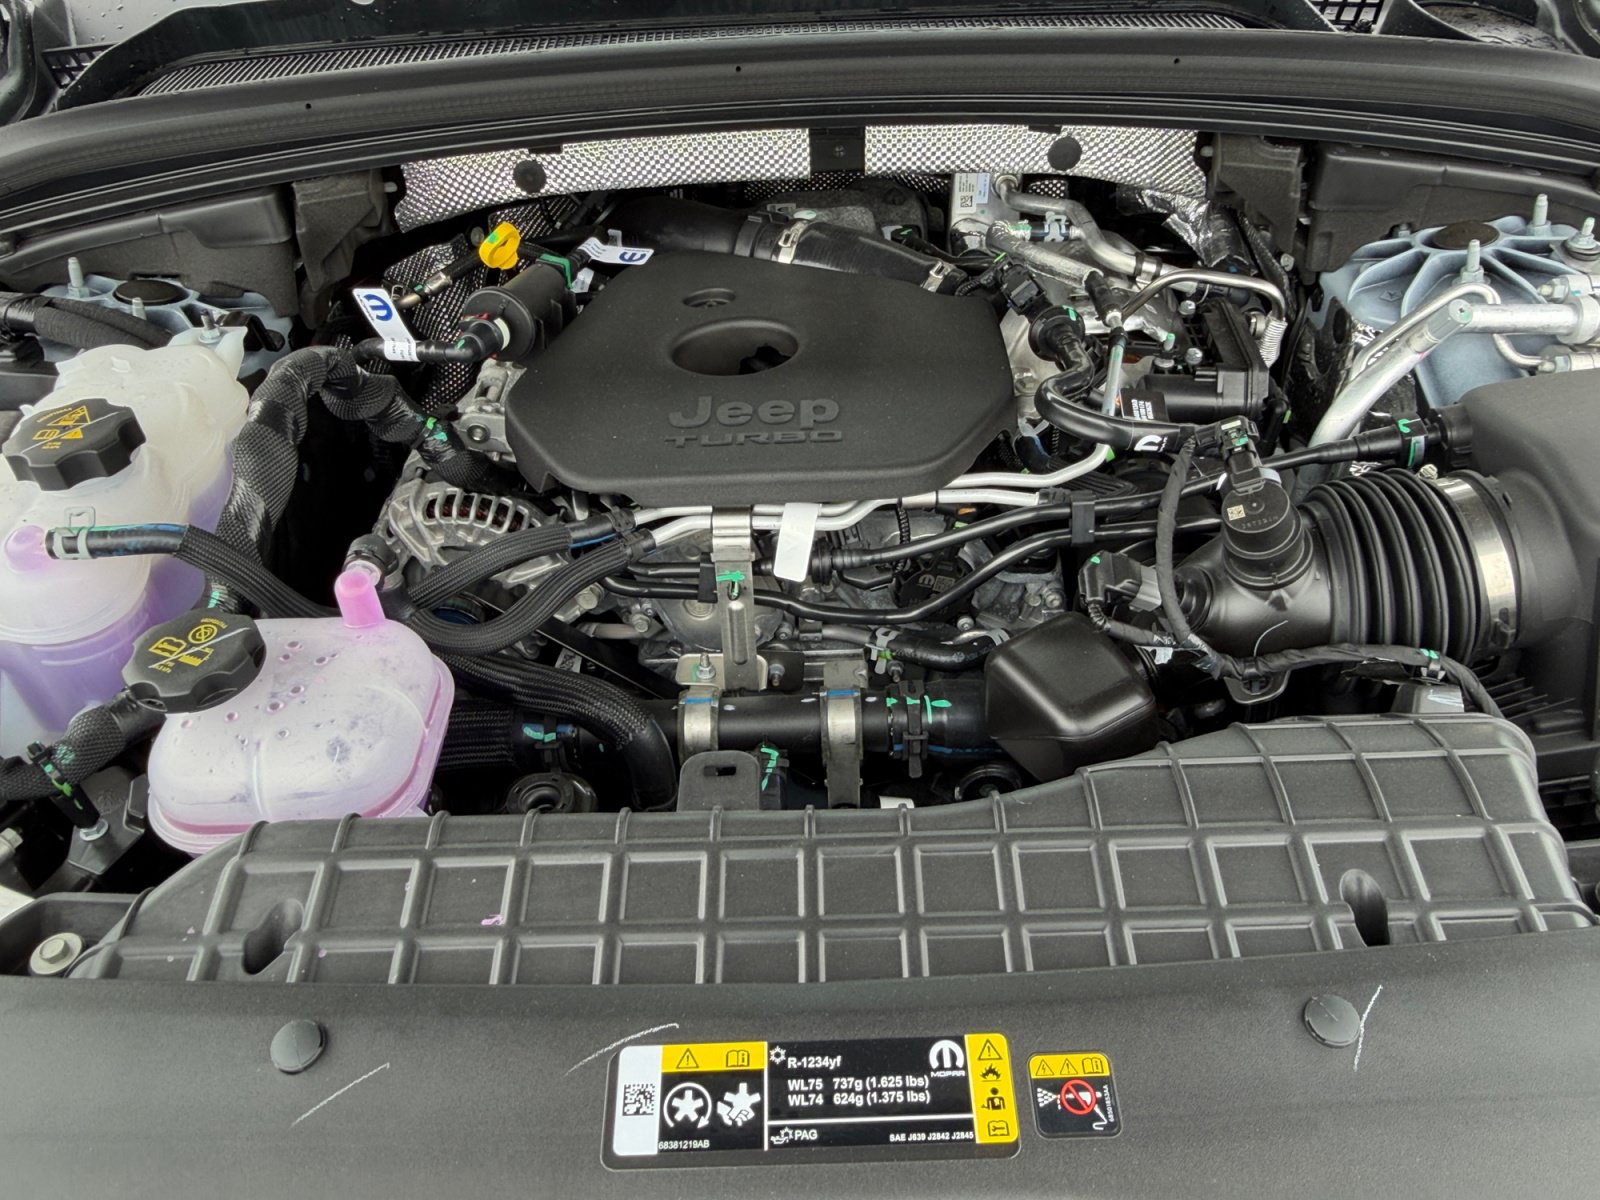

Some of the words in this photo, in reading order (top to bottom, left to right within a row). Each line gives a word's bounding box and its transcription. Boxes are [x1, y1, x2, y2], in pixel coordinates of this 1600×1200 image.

[668, 395, 840, 430] Jeep
[664, 430, 843, 448] TURBO
[787, 1055, 842, 1071] R-1234yf
[930, 1069, 966, 1078] MOPAR
[787, 1078, 824, 1092] WL75
[832, 1076, 863, 1092] 737g
[865, 1075, 904, 1091] (1.625
[905, 1074, 930, 1090] lbs)
[787, 1093, 825, 1107] WL74
[832, 1092, 864, 1108] 624g
[865, 1090, 905, 1107] (1.375
[906, 1089, 931, 1105] lbs)
[794, 1129, 819, 1142] PAG
[889, 1133, 907, 1143] SAE
[927, 1131, 951, 1142] J2842
[951, 1130, 975, 1141] J2845
[658, 1138, 710, 1151] 68381219AB
